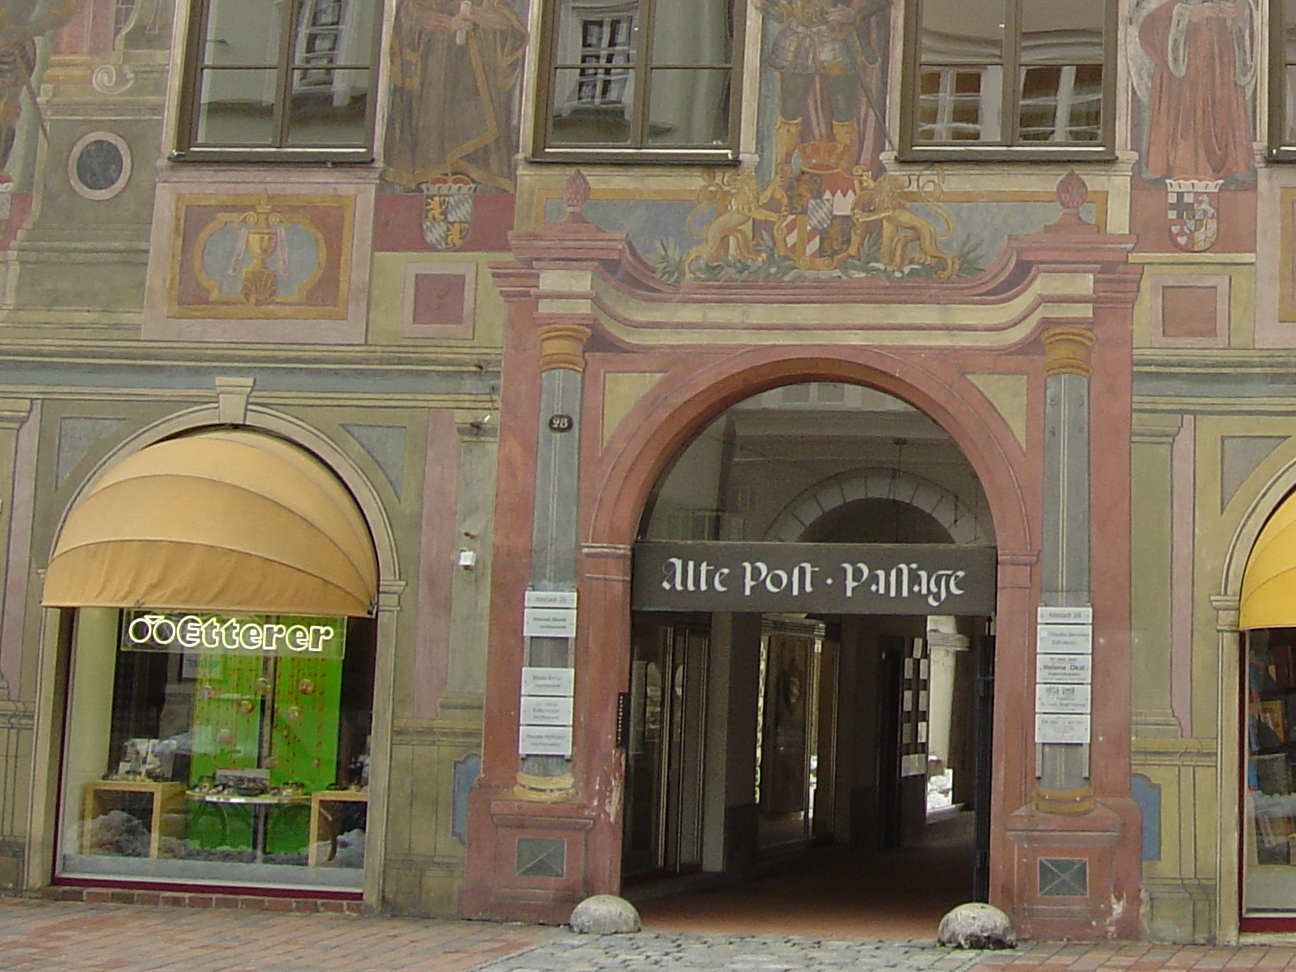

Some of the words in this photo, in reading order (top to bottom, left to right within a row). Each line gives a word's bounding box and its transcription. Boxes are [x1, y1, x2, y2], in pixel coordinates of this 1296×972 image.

[551, 416, 569, 429] 28
[661, 557, 731, 592] Alte
[176, 614, 335, 653] Etterer
